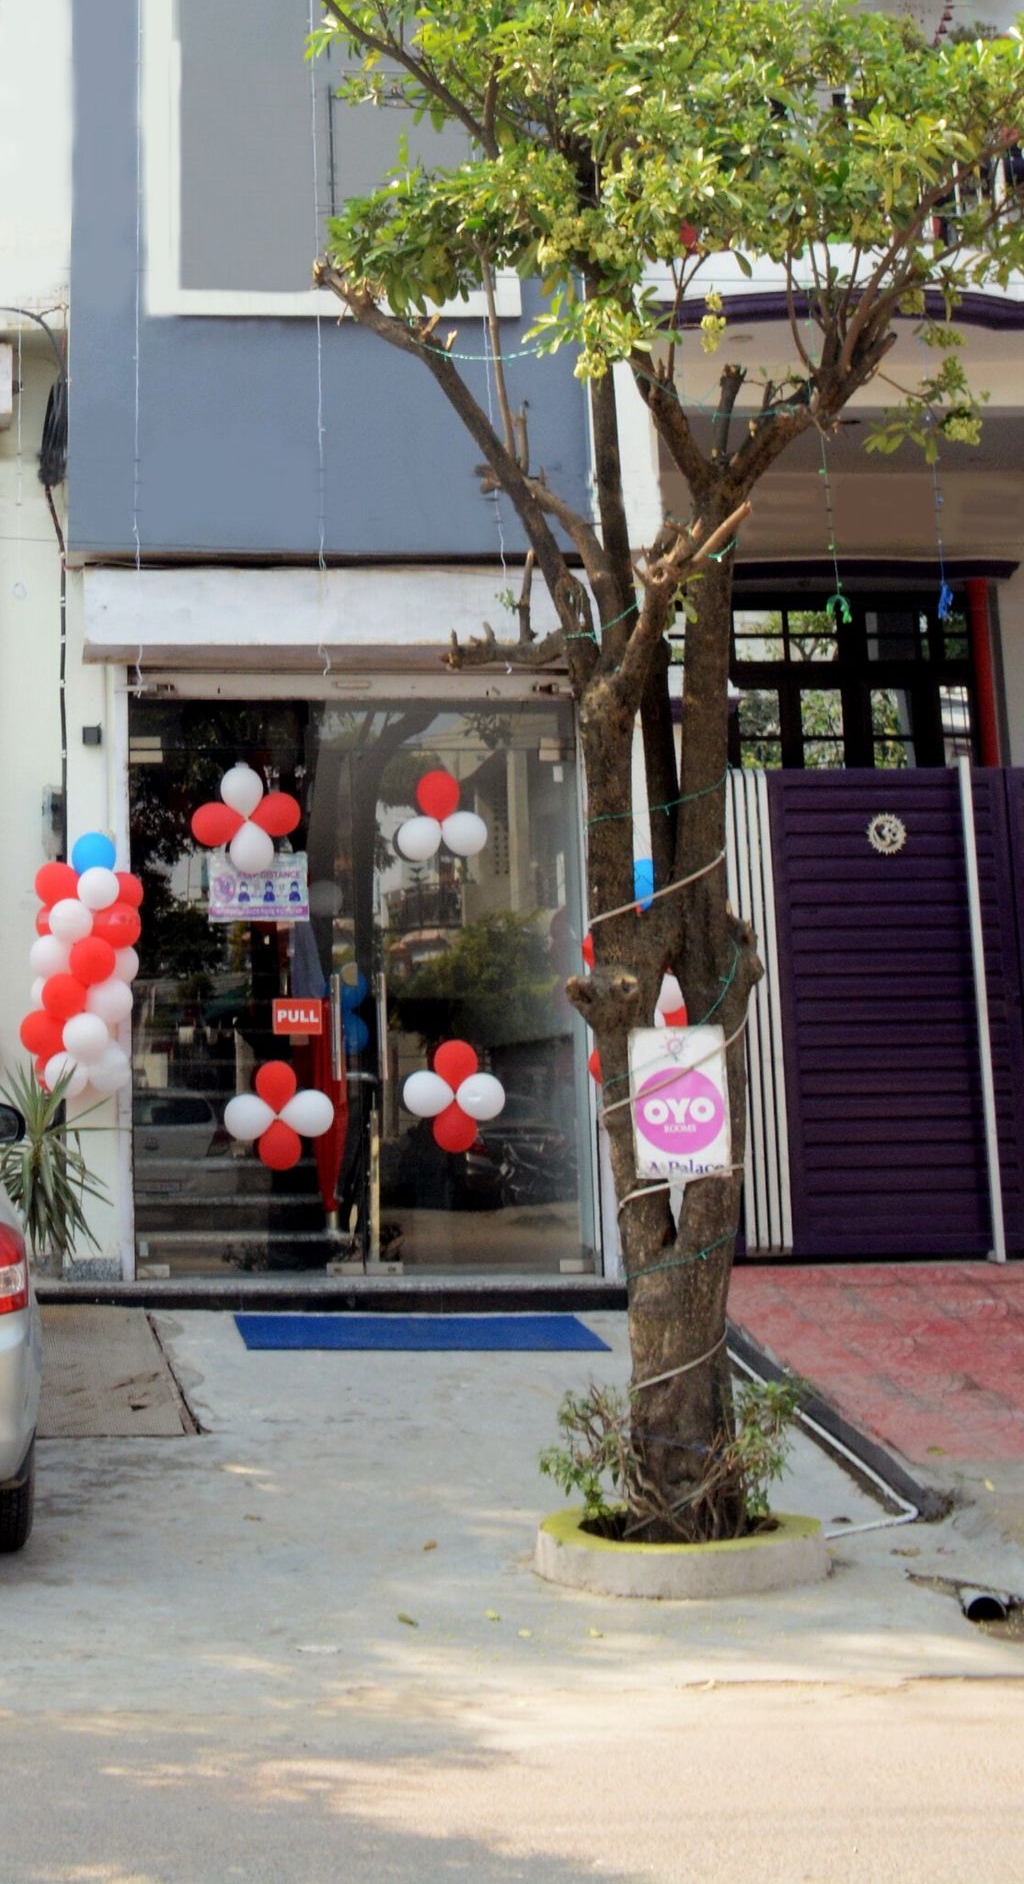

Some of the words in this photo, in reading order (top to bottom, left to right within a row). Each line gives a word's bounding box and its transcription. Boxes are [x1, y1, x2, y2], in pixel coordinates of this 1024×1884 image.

[276, 1009, 320, 1024] PULL
[643, 1096, 716, 1125] OYO
[664, 1124, 697, 1134] ROOMS
